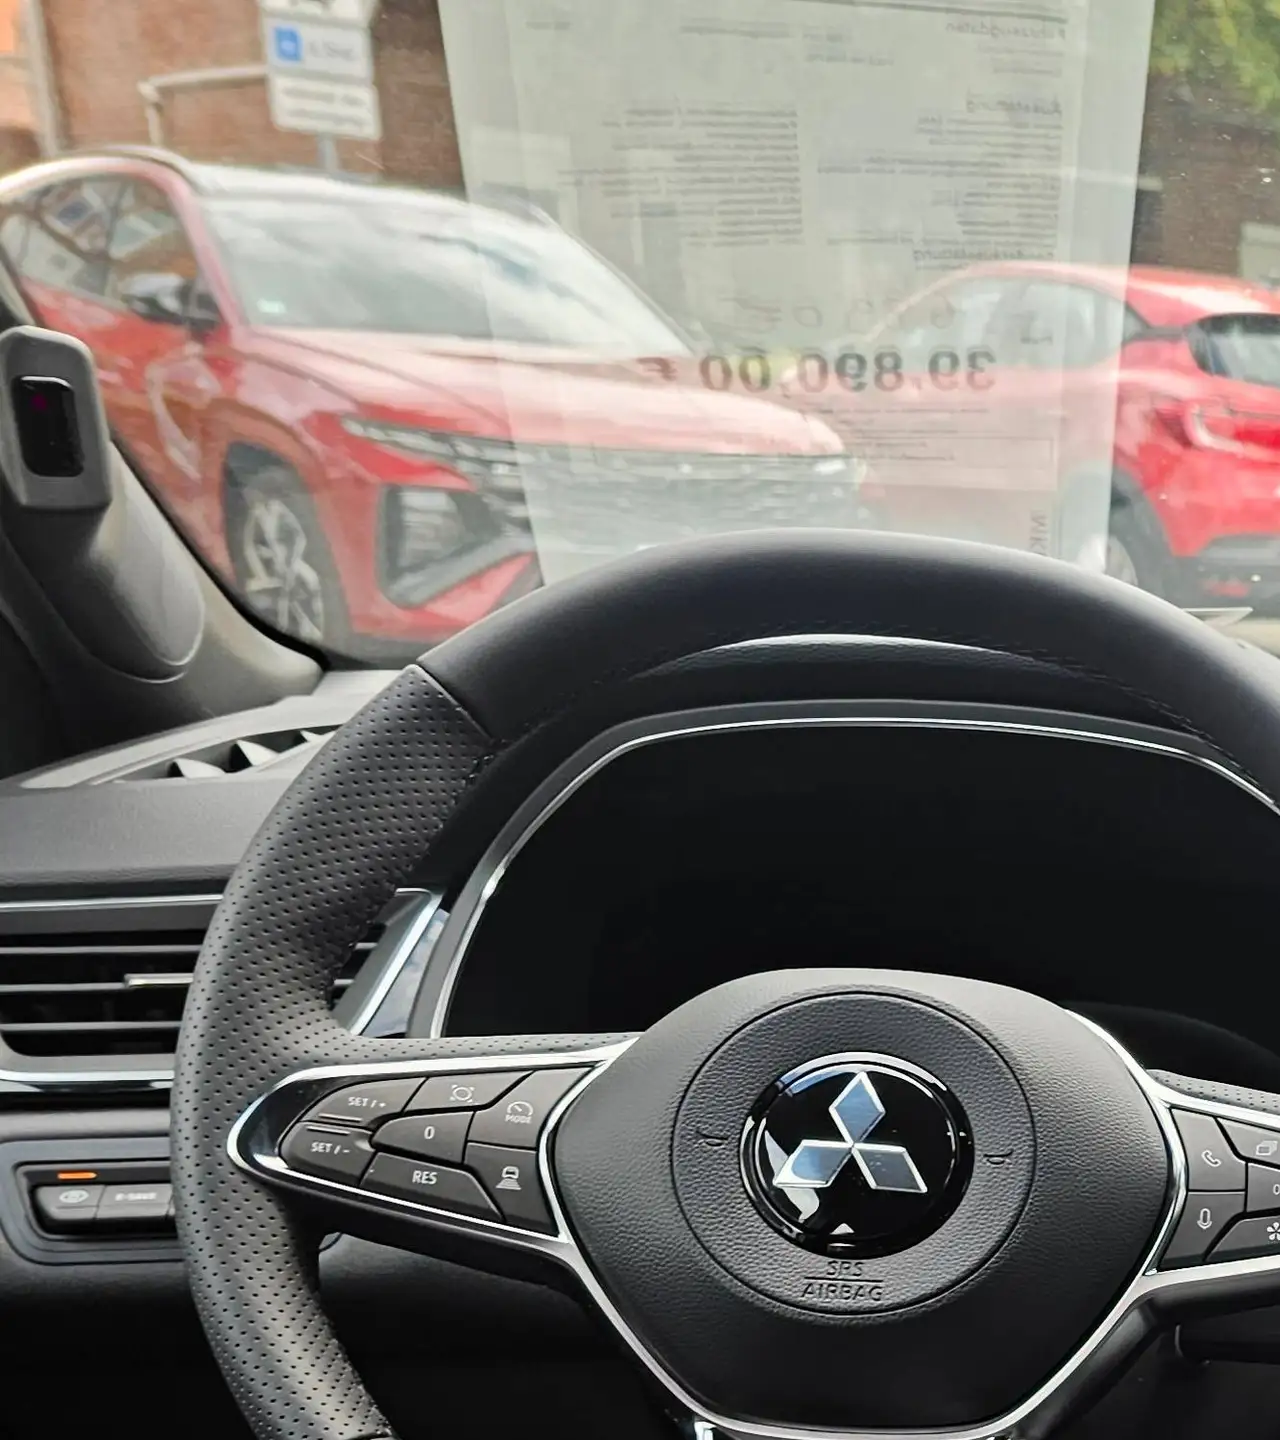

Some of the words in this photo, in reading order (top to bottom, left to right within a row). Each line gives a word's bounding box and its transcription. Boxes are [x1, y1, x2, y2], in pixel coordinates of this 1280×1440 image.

[348, 1096, 368, 1108] SET
[311, 1141, 332, 1154] SET
[412, 1170, 437, 1185] RES
[825, 1260, 864, 1278] SRS
[800, 1282, 885, 1303] AIRBAG
